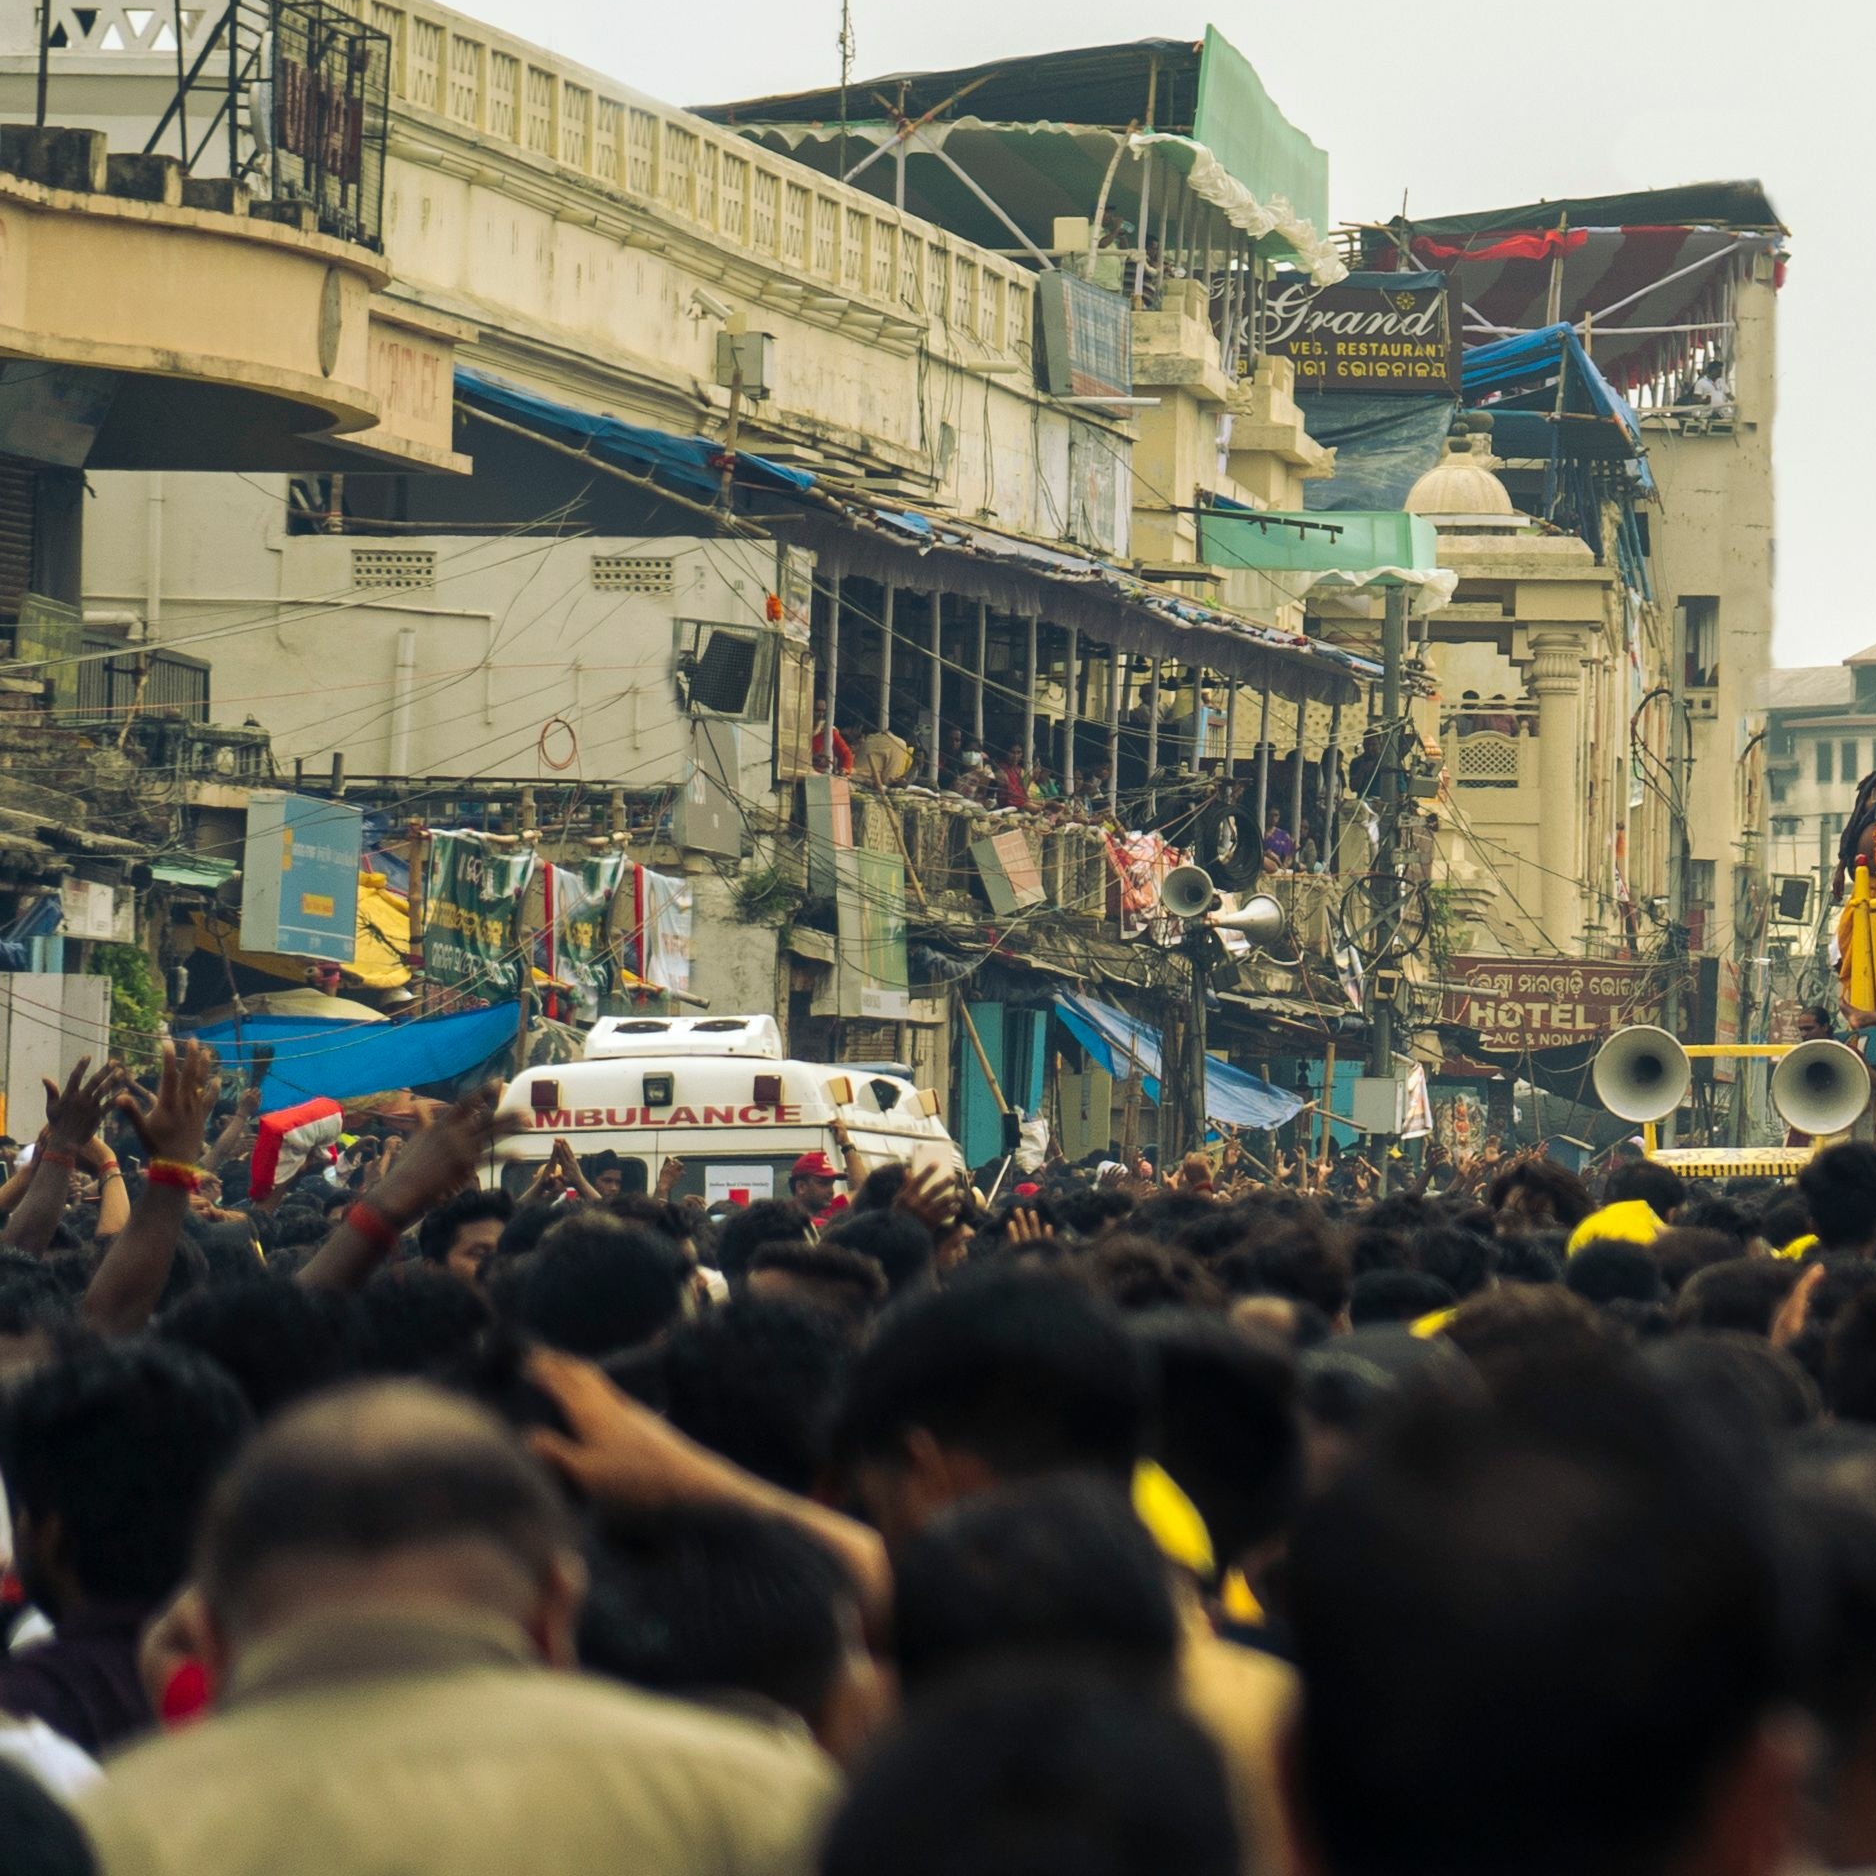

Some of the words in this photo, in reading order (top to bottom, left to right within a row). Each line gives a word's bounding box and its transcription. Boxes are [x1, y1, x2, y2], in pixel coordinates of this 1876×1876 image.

[1240, 282, 1447, 346] Grand
[1290, 341, 1329, 357] VEG.
[1336, 342, 1446, 358] RESTAURANT
[1469, 1000, 1599, 1029] HOTEL
[1493, 1032, 1520, 1045] A/C
[1525, 1032, 1535, 1045] &
[1539, 1032, 1574, 1046] NON
[528, 1104, 802, 1128] MBULANCE
